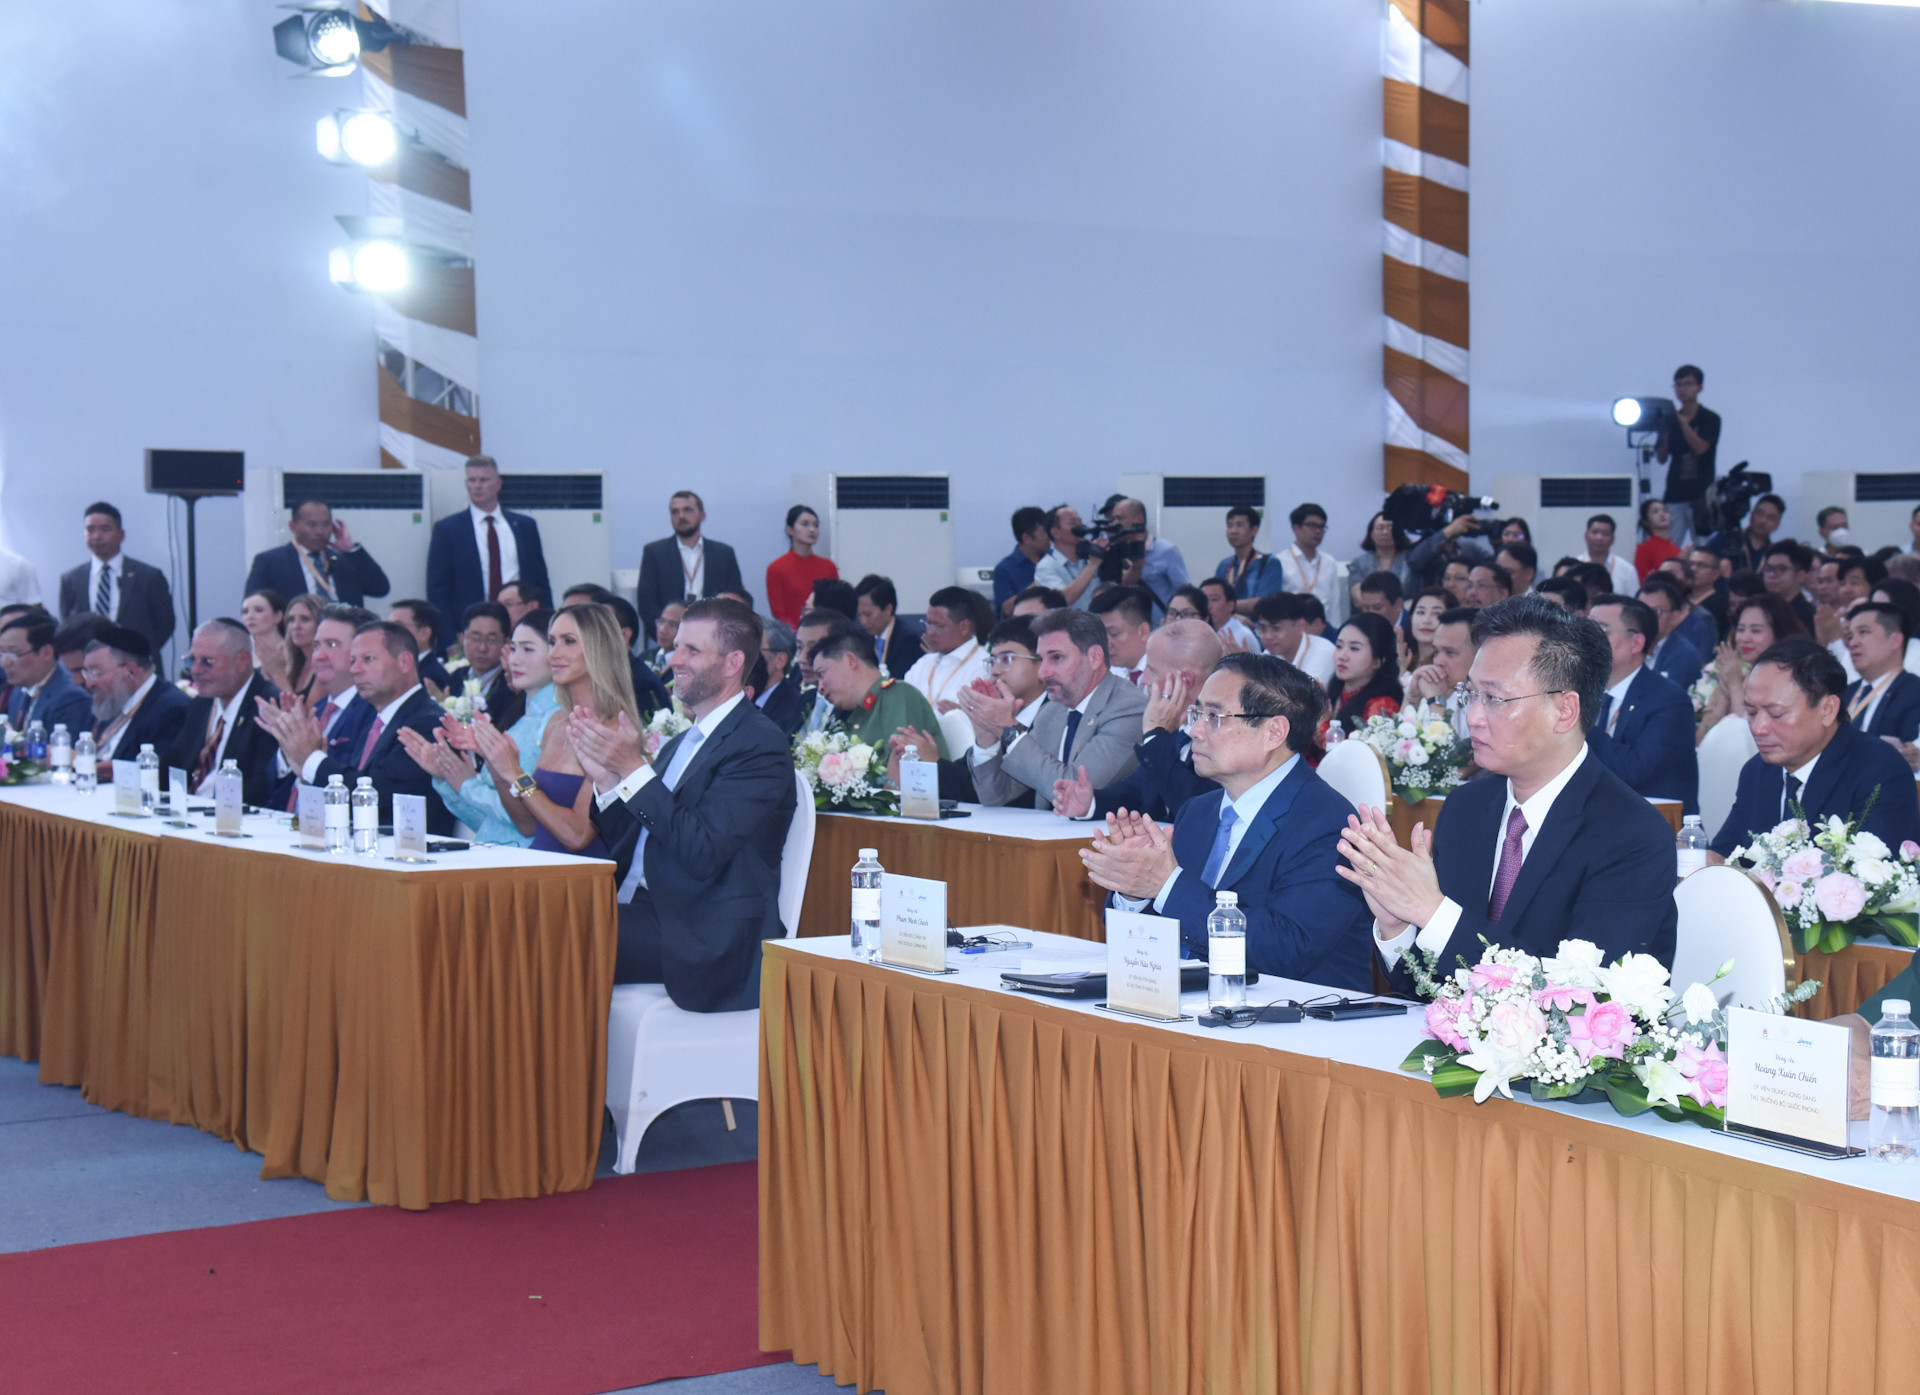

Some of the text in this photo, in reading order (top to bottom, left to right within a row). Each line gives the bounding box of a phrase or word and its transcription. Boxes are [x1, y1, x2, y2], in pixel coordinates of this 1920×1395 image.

[1754, 1062, 1817, 1084] Hoàng Xuân Chiến
